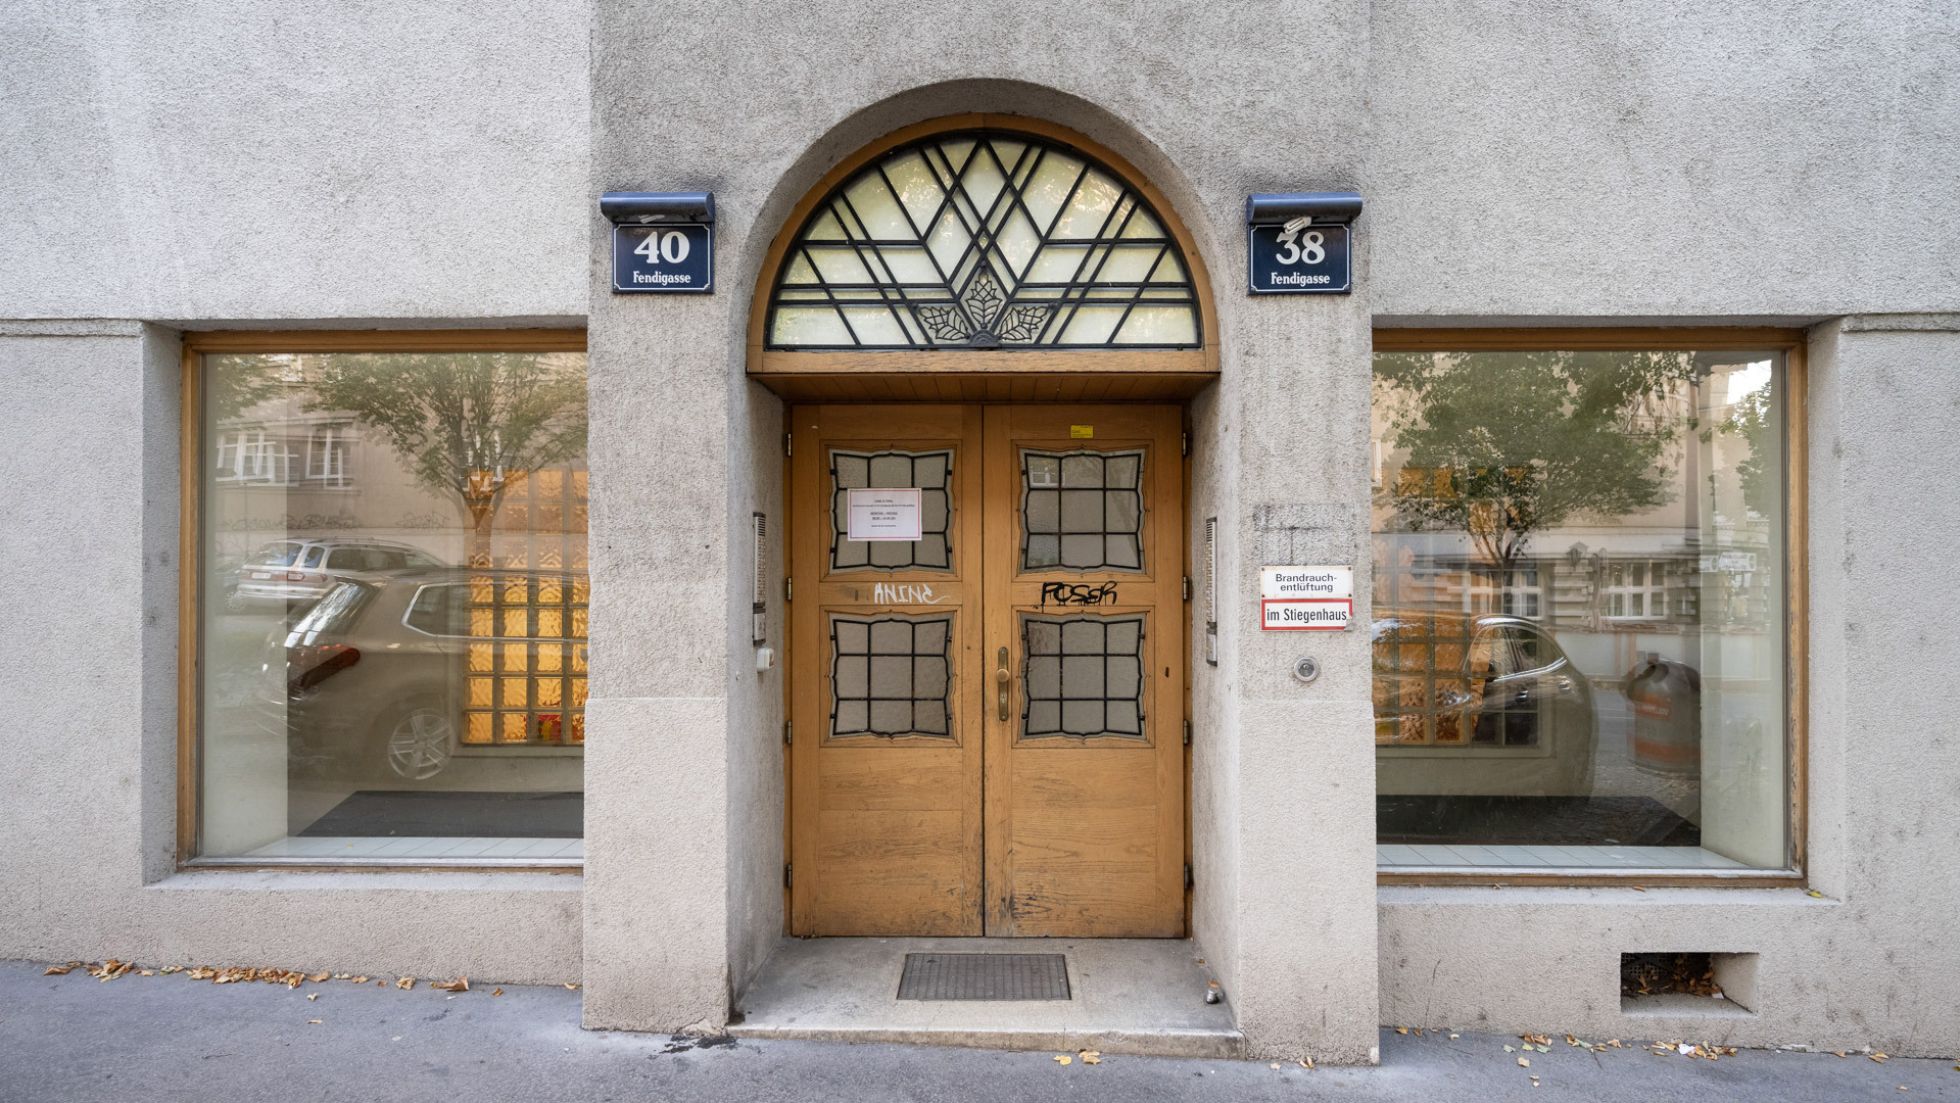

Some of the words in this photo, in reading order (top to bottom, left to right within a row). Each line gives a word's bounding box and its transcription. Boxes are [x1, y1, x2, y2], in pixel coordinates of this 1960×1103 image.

[633, 231, 690, 264] 40
[1275, 231, 1326, 265] 38
[633, 271, 691, 286] Fendigasse
[1271, 272, 1330, 287] Fendigasse
[1275, 573, 1337, 582] Brandrauch-
[1280, 583, 1334, 592] entlüftung
[1266, 608, 1280, 620] im
[1283, 608, 1347, 623] Stiegenhaus
